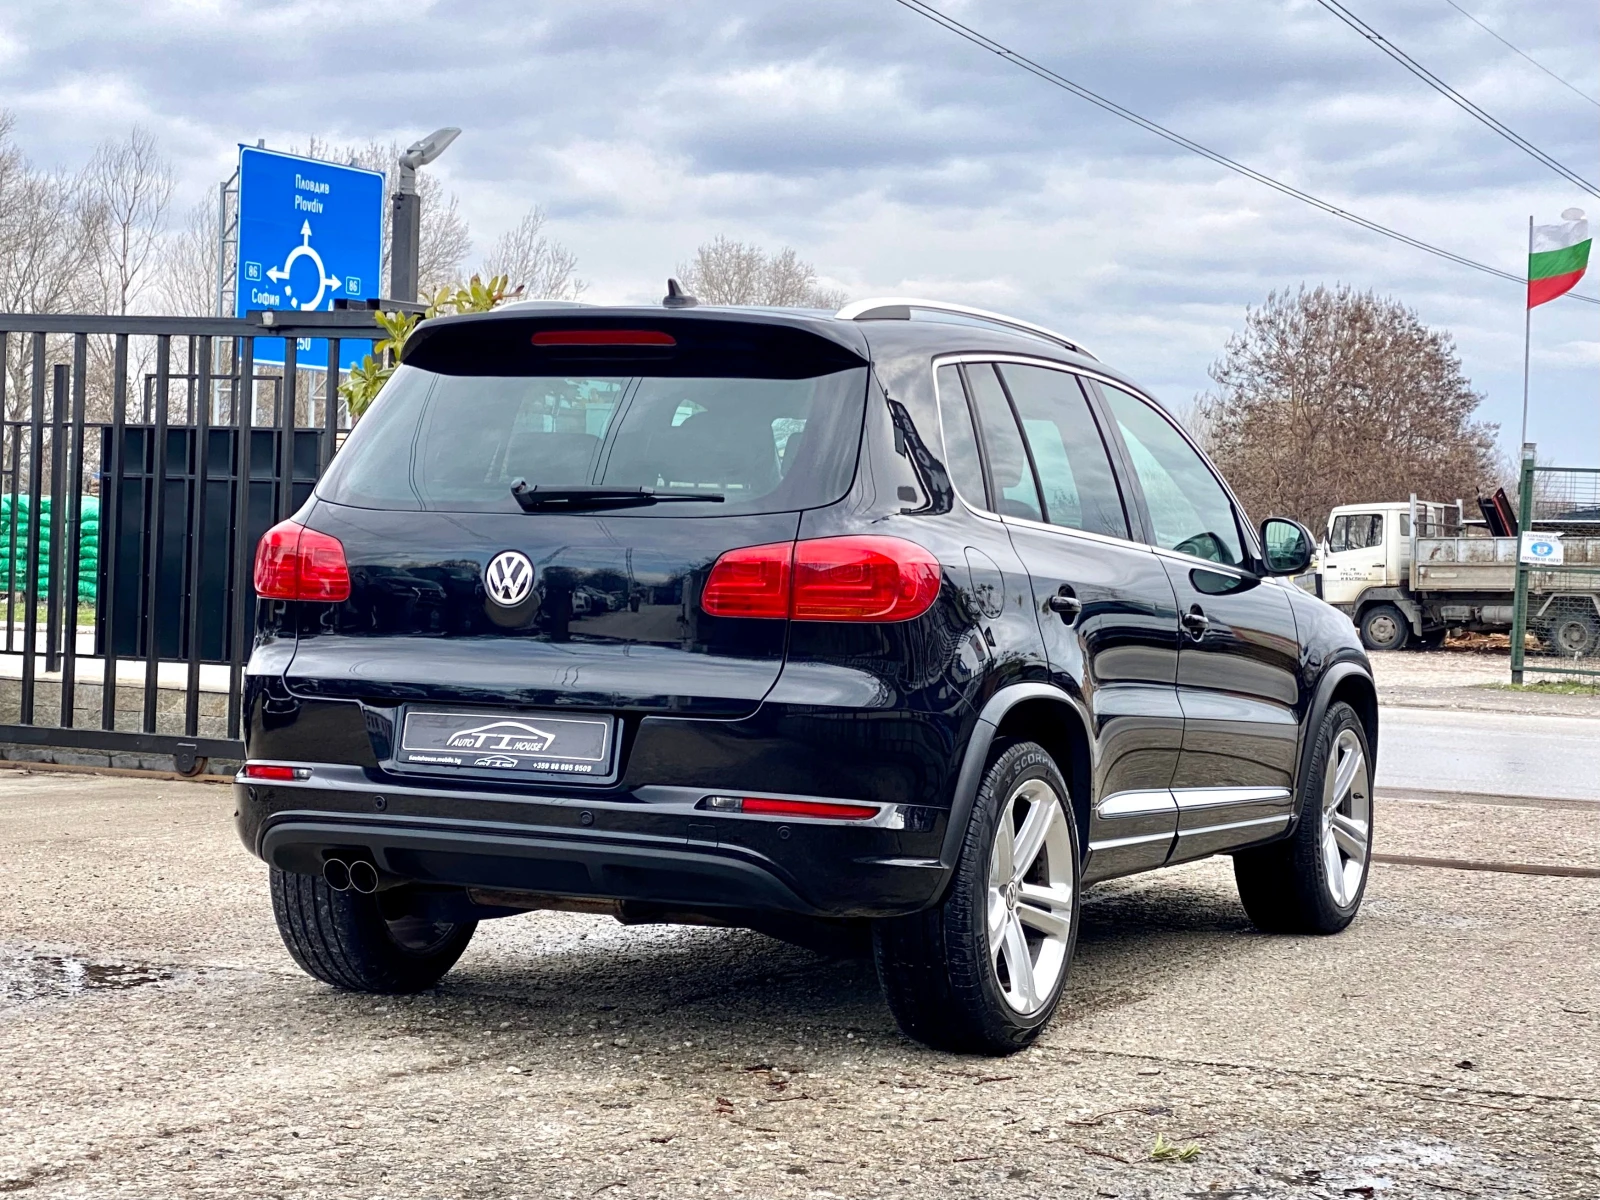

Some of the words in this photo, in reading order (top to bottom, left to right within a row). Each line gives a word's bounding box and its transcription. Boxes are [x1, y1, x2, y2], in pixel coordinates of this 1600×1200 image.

[295, 174, 330, 195] Пловдив
[295, 195, 323, 213] Plovdiv
[248, 265, 258, 278] 86
[349, 280, 358, 292] 86
[252, 288, 280, 306] София
[451, 738, 474, 747] AUTO
[513, 742, 544, 752] HOUSE
[533, 761, 550, 770] +359
